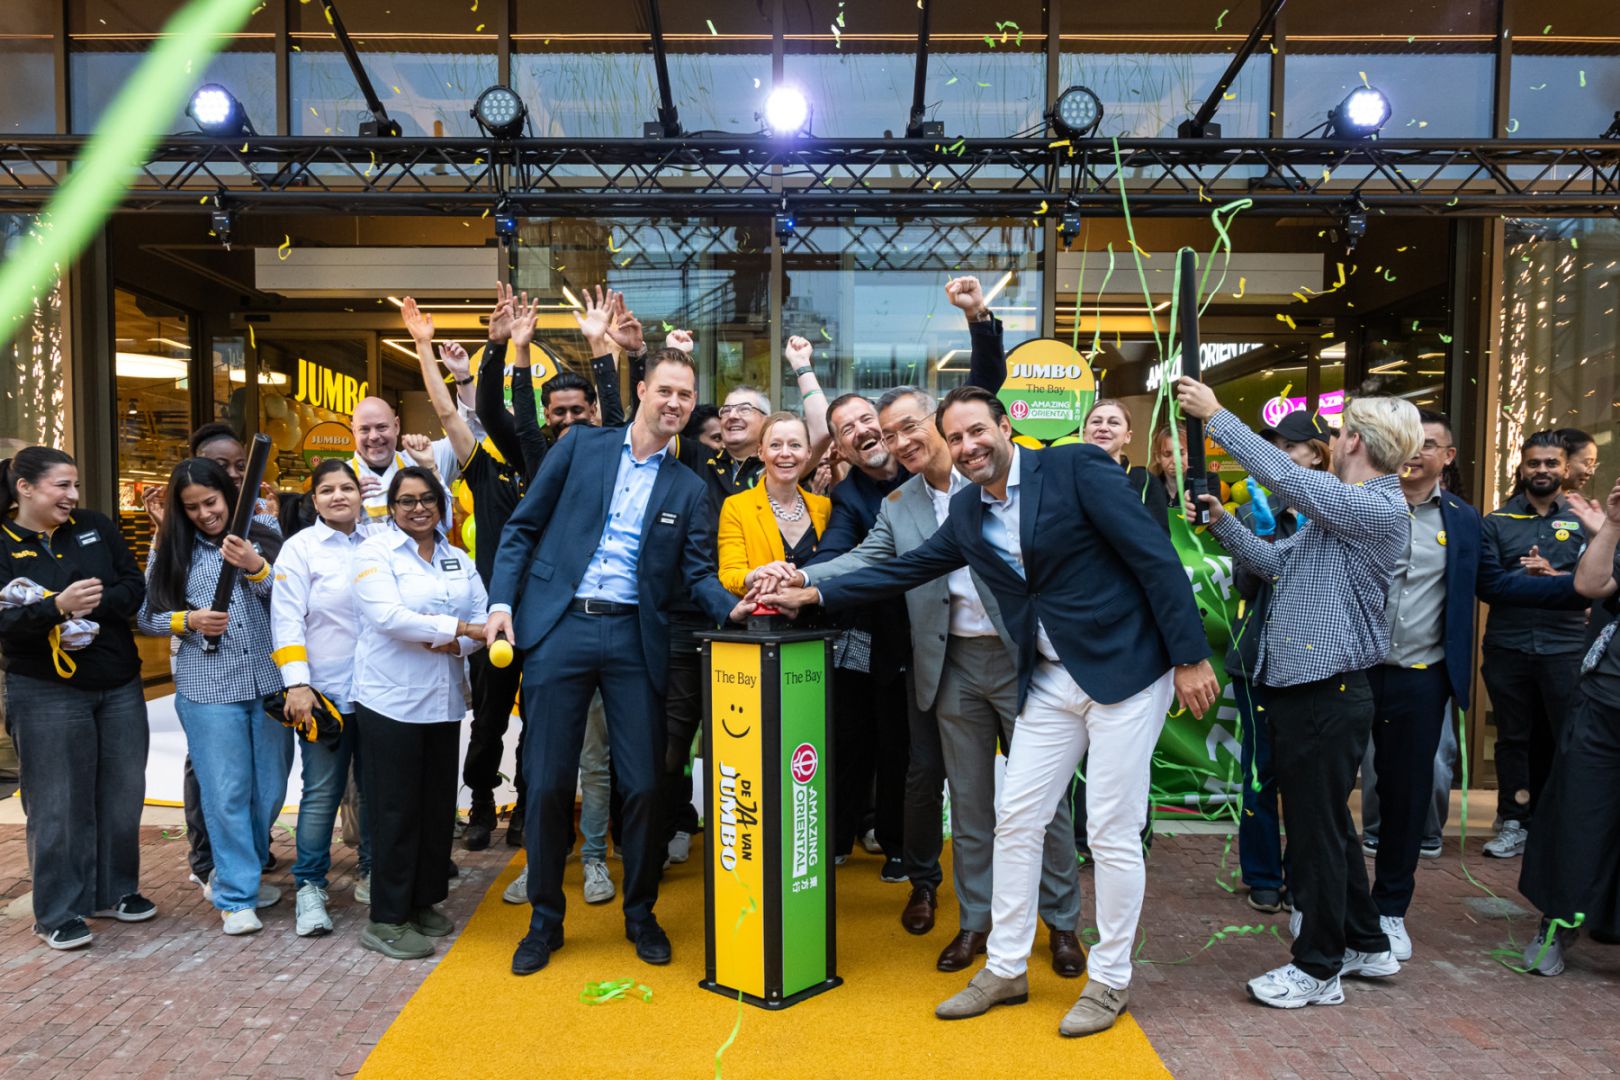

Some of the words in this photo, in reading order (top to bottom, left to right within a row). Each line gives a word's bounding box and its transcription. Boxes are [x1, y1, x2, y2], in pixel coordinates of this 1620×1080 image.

[1011, 363, 1082, 379] JUMBO
[1026, 384, 1045, 393] The
[1047, 384, 1065, 395] Bay
[311, 435, 350, 445] JUMBO
[715, 669, 735, 684] The
[737, 671, 757, 689] Bay
[785, 671, 803, 685] The
[805, 669, 822, 684] Bay
[741, 779, 751, 798] DE
[719, 761, 738, 872] JUMBO
[734, 796, 758, 831] JA
[795, 789, 806, 873] ORIENTAL
[808, 785, 818, 867] AMAZING
[741, 833, 752, 861] VAN
